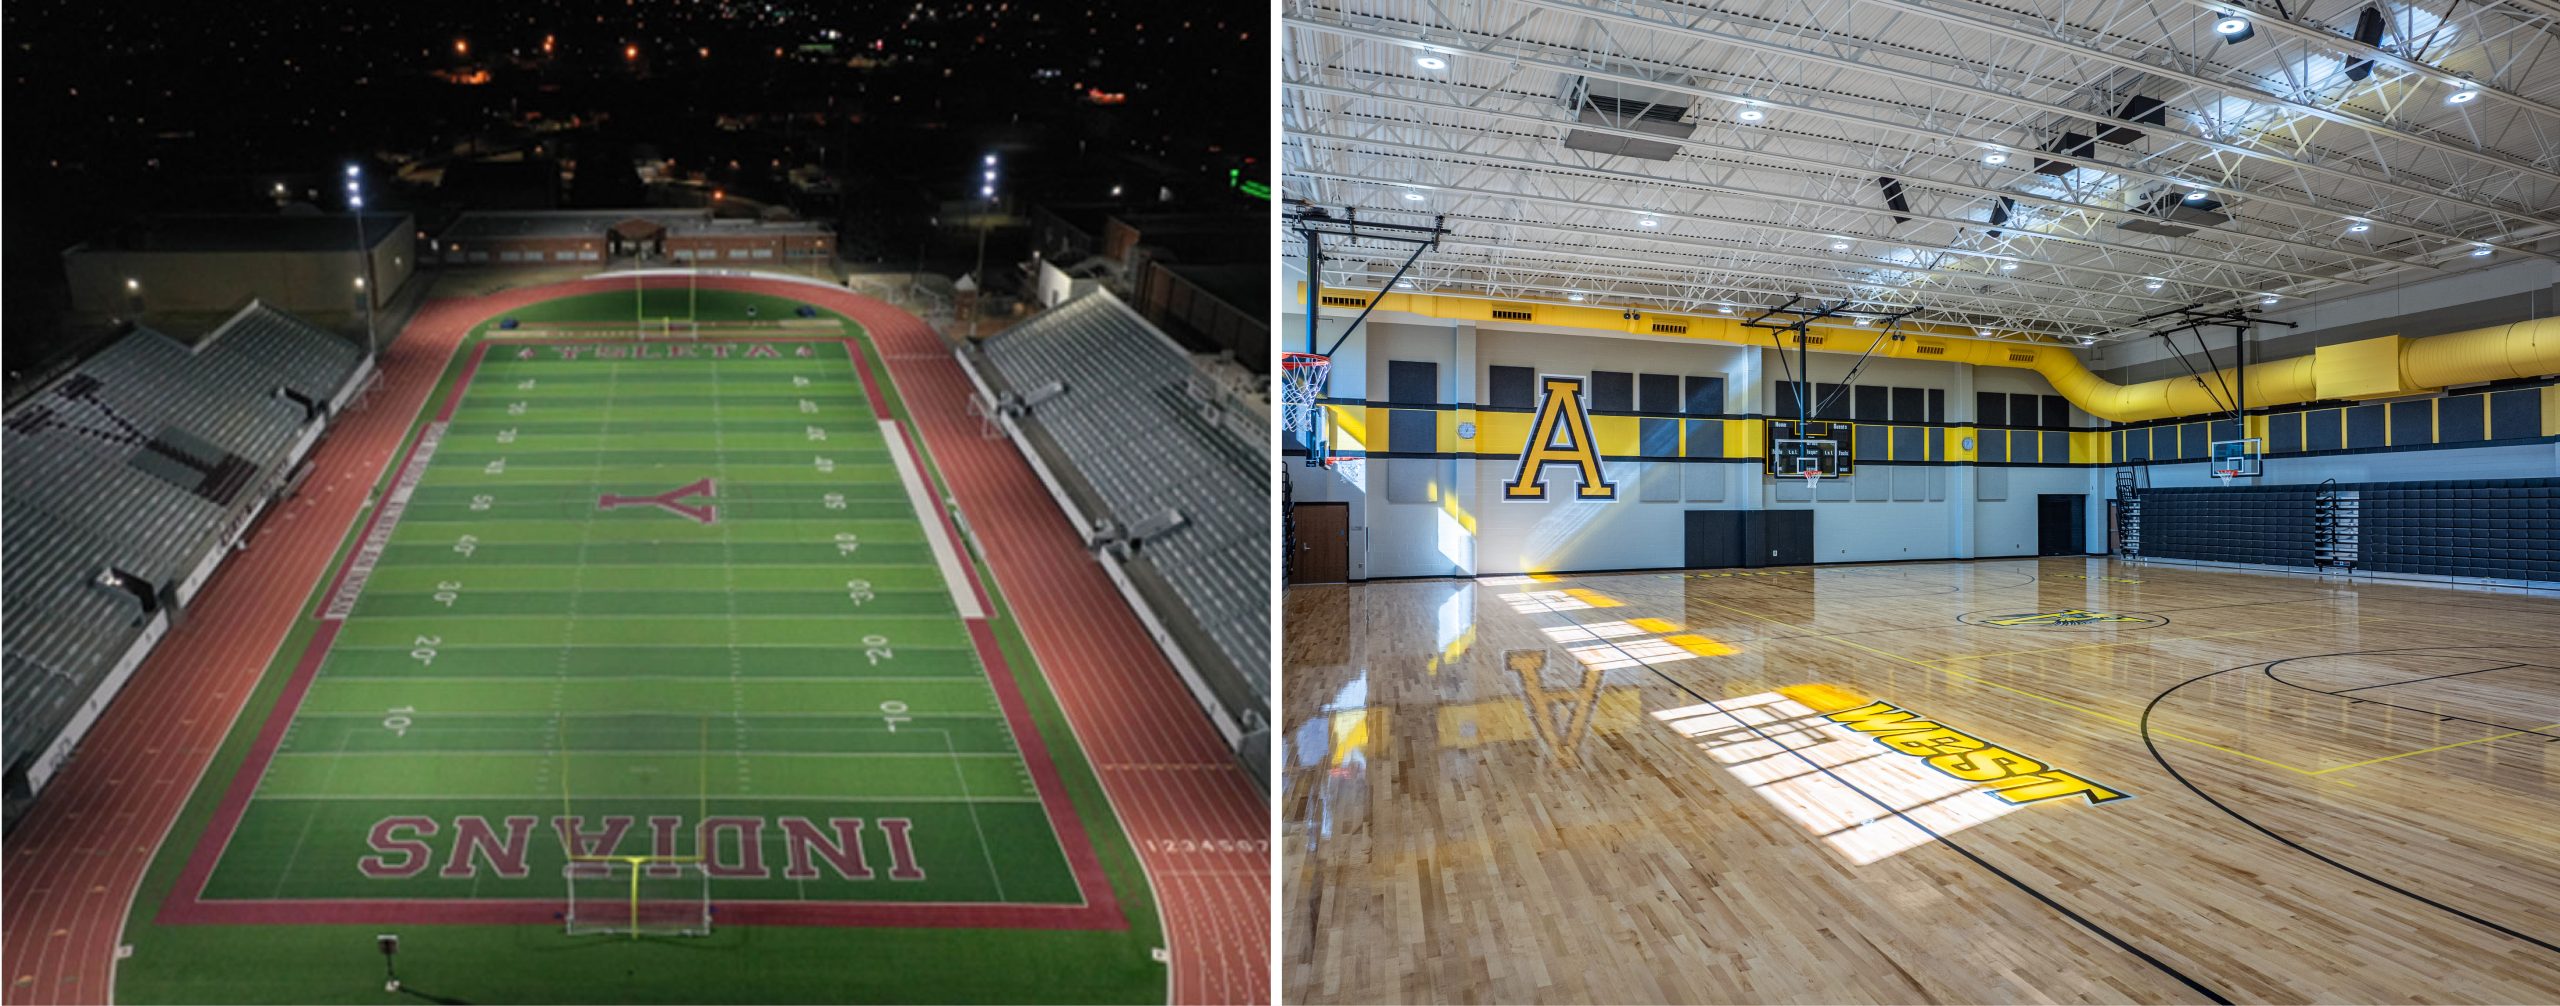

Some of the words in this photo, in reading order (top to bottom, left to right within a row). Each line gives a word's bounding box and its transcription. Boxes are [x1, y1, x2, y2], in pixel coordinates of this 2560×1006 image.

[553, 343, 781, 360] YSLETA
[1501, 373, 1619, 502] A
[470, 494, 494, 511] 50
[599, 478, 719, 524] Y
[823, 492, 847, 510] 50
[433, 581, 462, 602] 30
[848, 579, 874, 601] 30
[411, 635, 441, 659] 20
[862, 634, 893, 661] 20
[383, 706, 415, 729] 10
[880, 700, 912, 724] 10
[357, 816, 926, 880] INDIANS
[1146, 839, 1157, 852] 1
[1163, 839, 1177, 852] 2
[1180, 839, 1195, 852] 3
[1201, 839, 1215, 852] 4
[1256, 839, 1269, 852] 7
